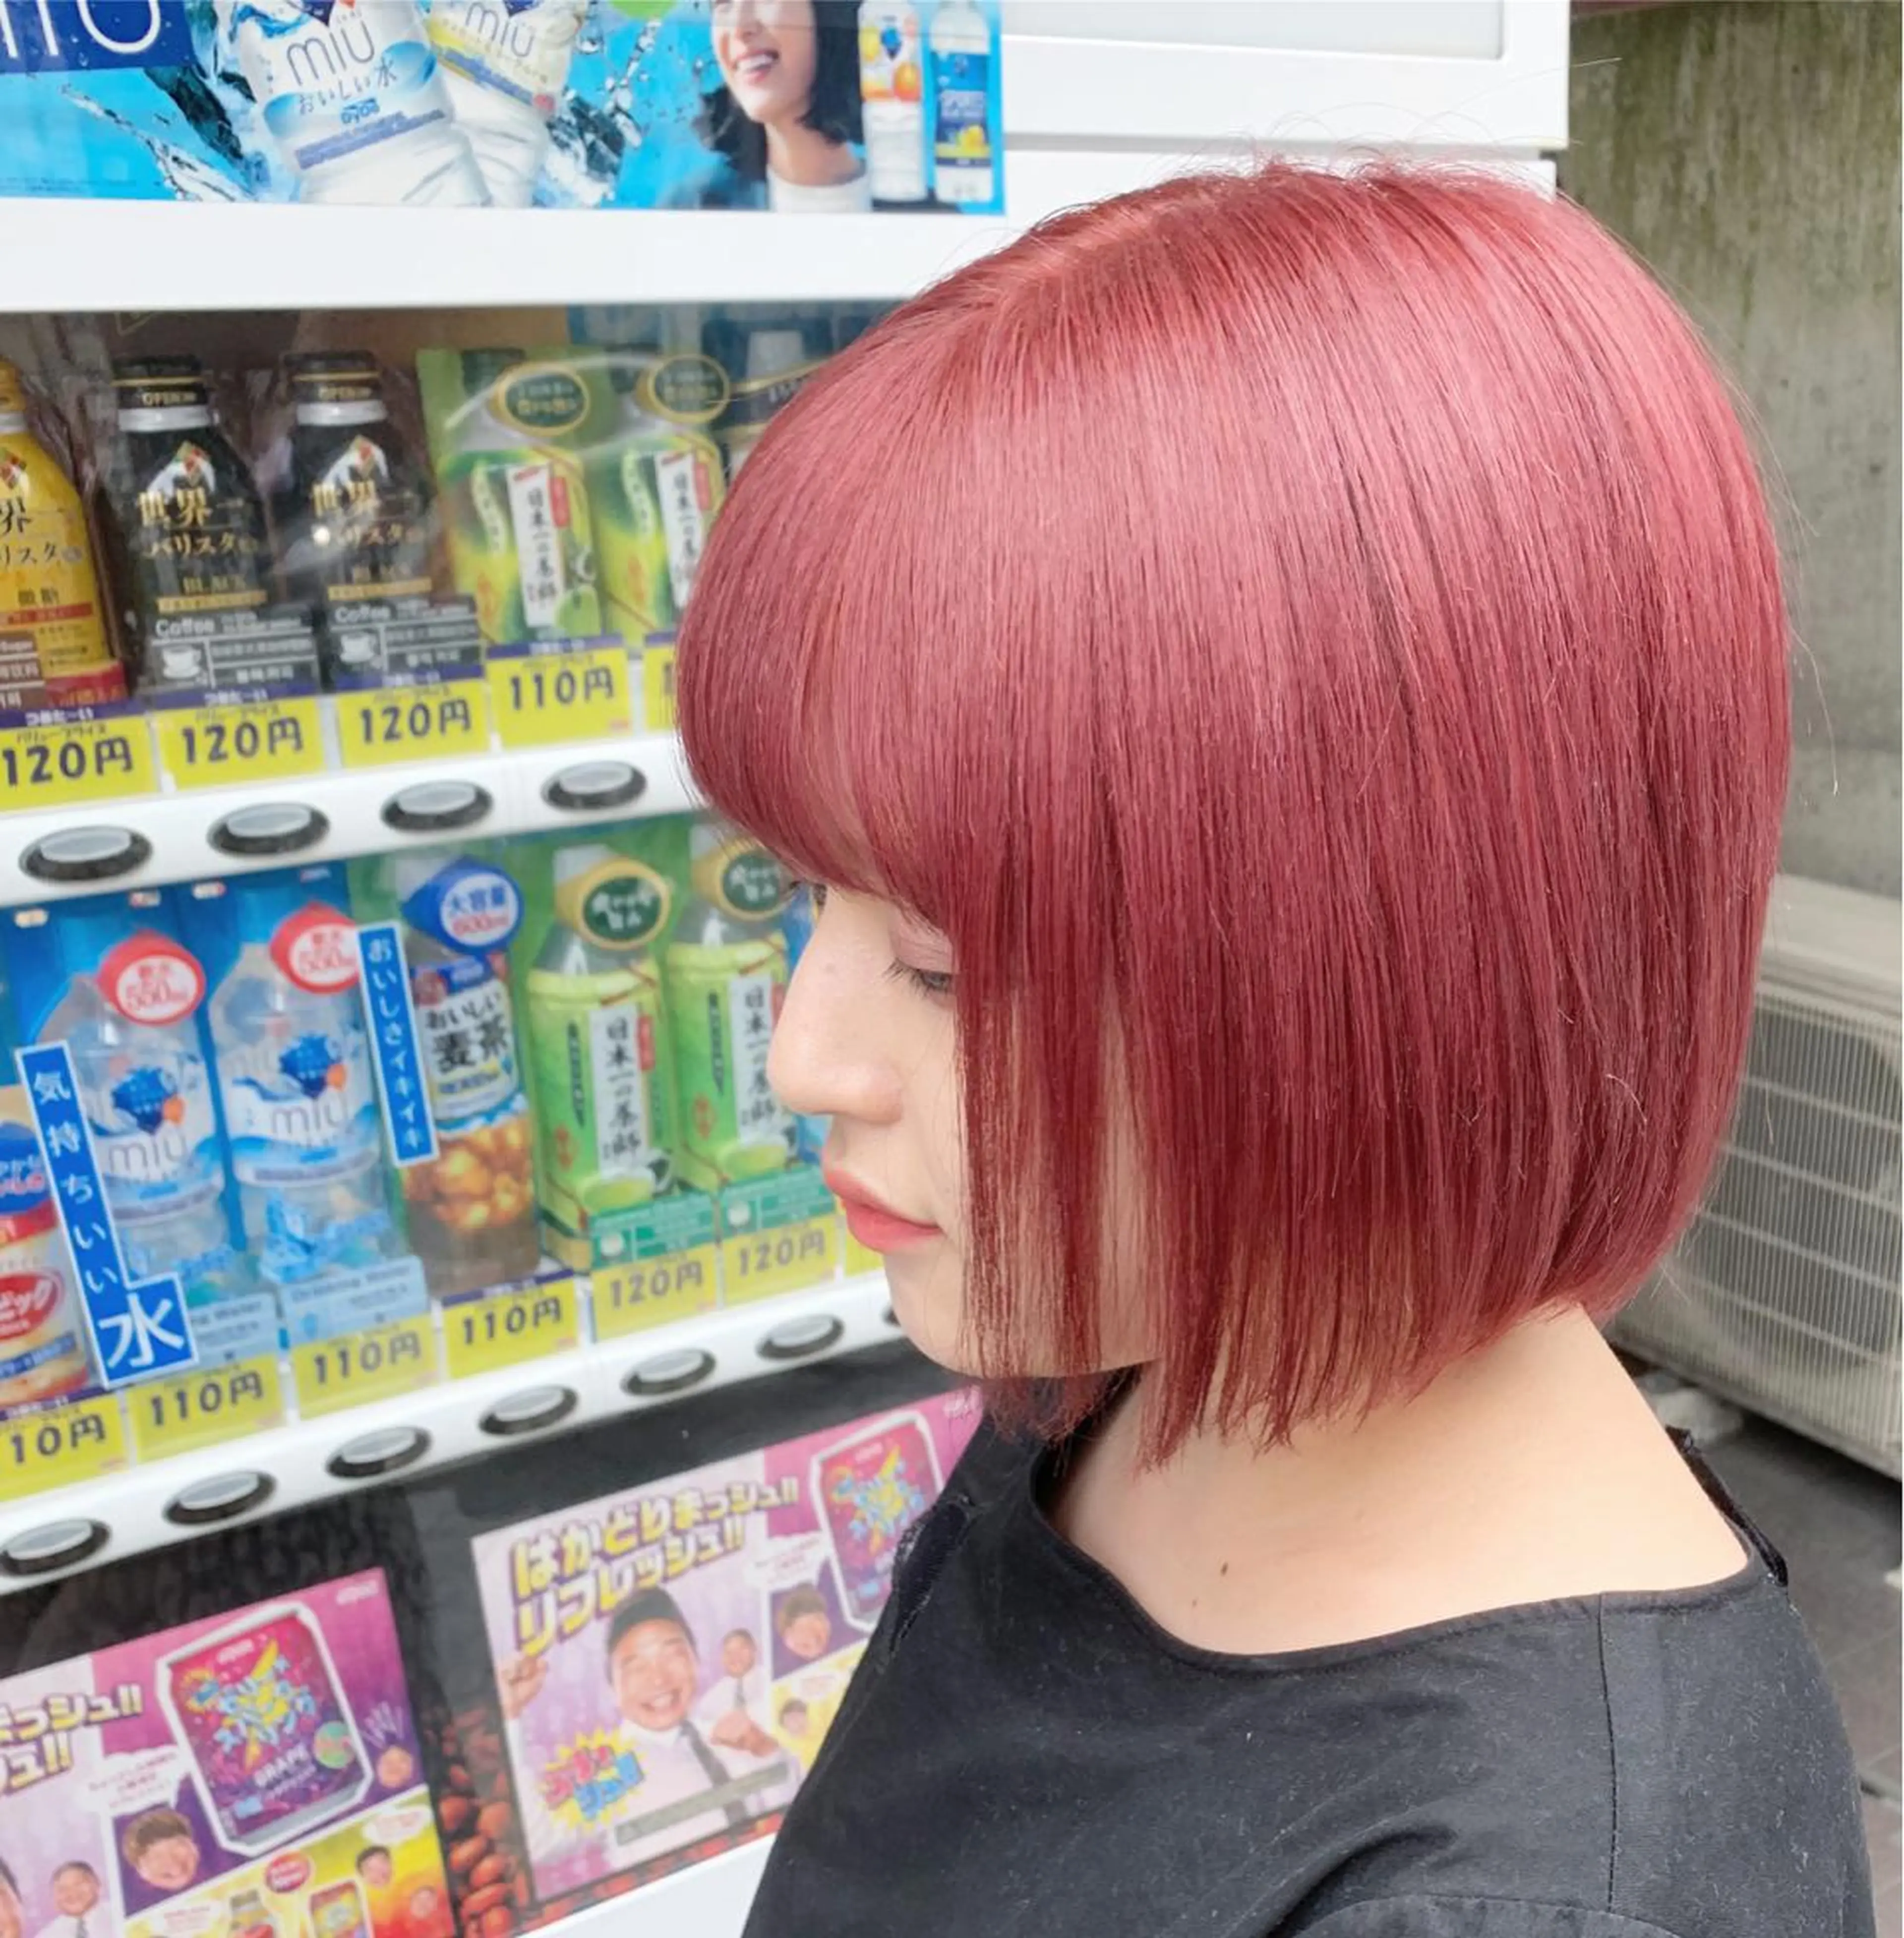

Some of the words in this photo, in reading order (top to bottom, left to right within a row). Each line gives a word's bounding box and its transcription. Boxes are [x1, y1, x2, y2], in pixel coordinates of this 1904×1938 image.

[510, 664, 614, 711] 110円
[180, 716, 303, 764] 120円
[359, 698, 472, 744] 120円
[2, 736, 134, 787] 120円
[432, 1014, 508, 1075] 麦茶
[738, 1228, 826, 1276] 120円
[609, 1260, 704, 1310] 120円
[462, 1296, 562, 1345] 110円
[313, 1332, 421, 1384] 110円
[151, 1369, 264, 1426] 110円
[11, 1412, 106, 1464] 10円
[0, 1683, 143, 1745] っシュ!!
